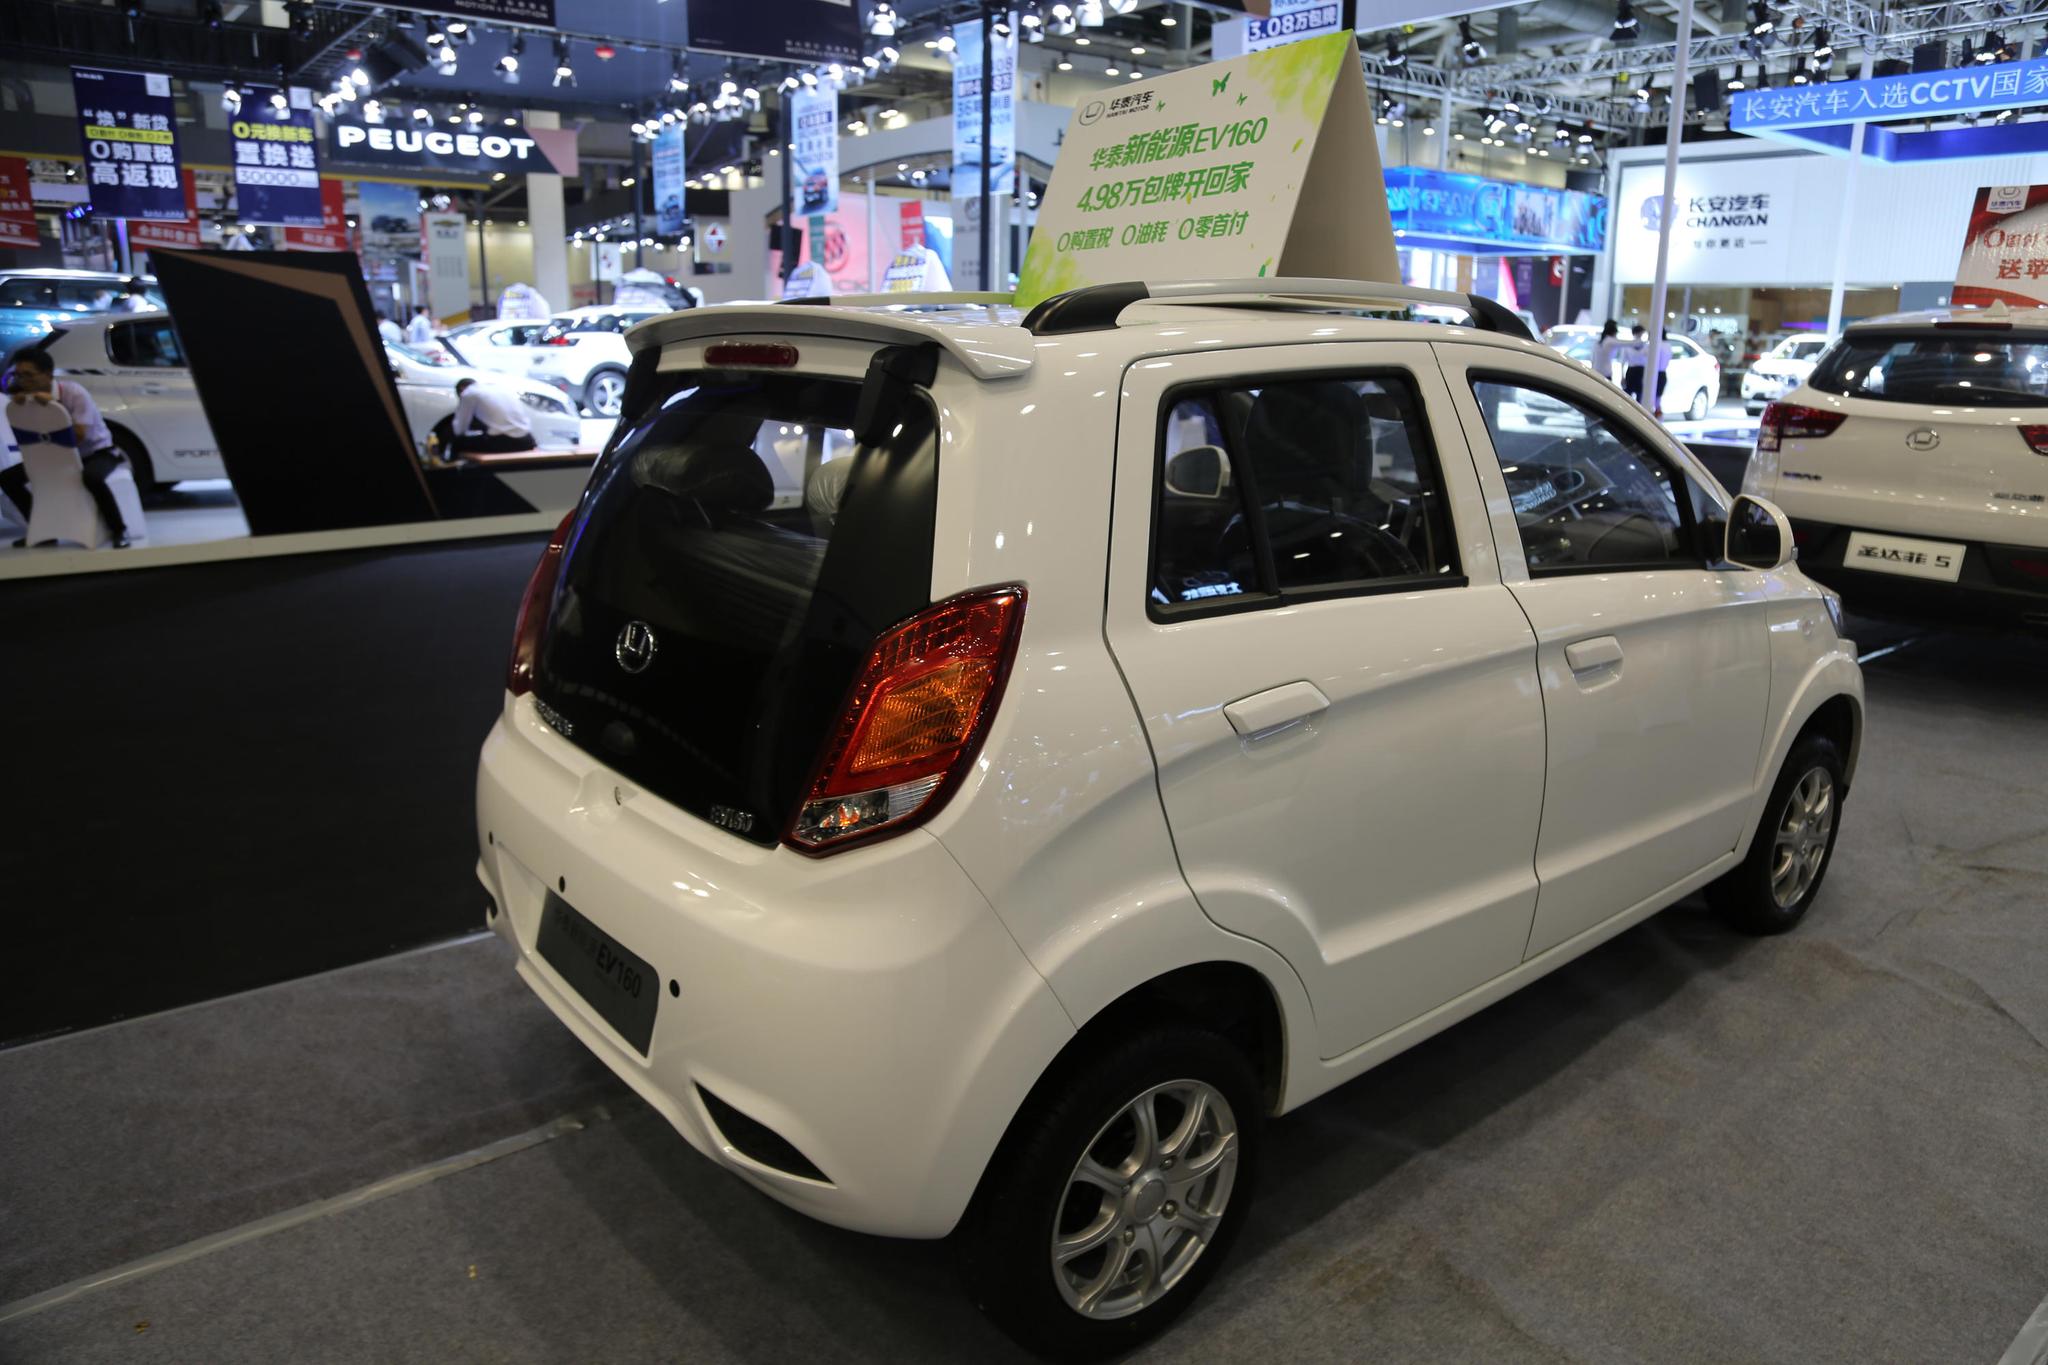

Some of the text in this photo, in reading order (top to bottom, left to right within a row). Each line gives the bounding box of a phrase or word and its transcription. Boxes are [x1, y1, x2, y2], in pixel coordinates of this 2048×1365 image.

[337, 125, 535, 159] PEUGEOT
[1089, 117, 1269, 171] 华泰新能源EV160
[91, 162, 178, 188] 高返现
[1076, 161, 1255, 212] 4.98万包牌开回家
[1686, 213, 1769, 228] CHANGAN
[1689, 194, 1770, 213] 长安汽车
[1057, 210, 1250, 252] 0购置税 0油耗 0零首付
[596, 943, 642, 998] EV160
